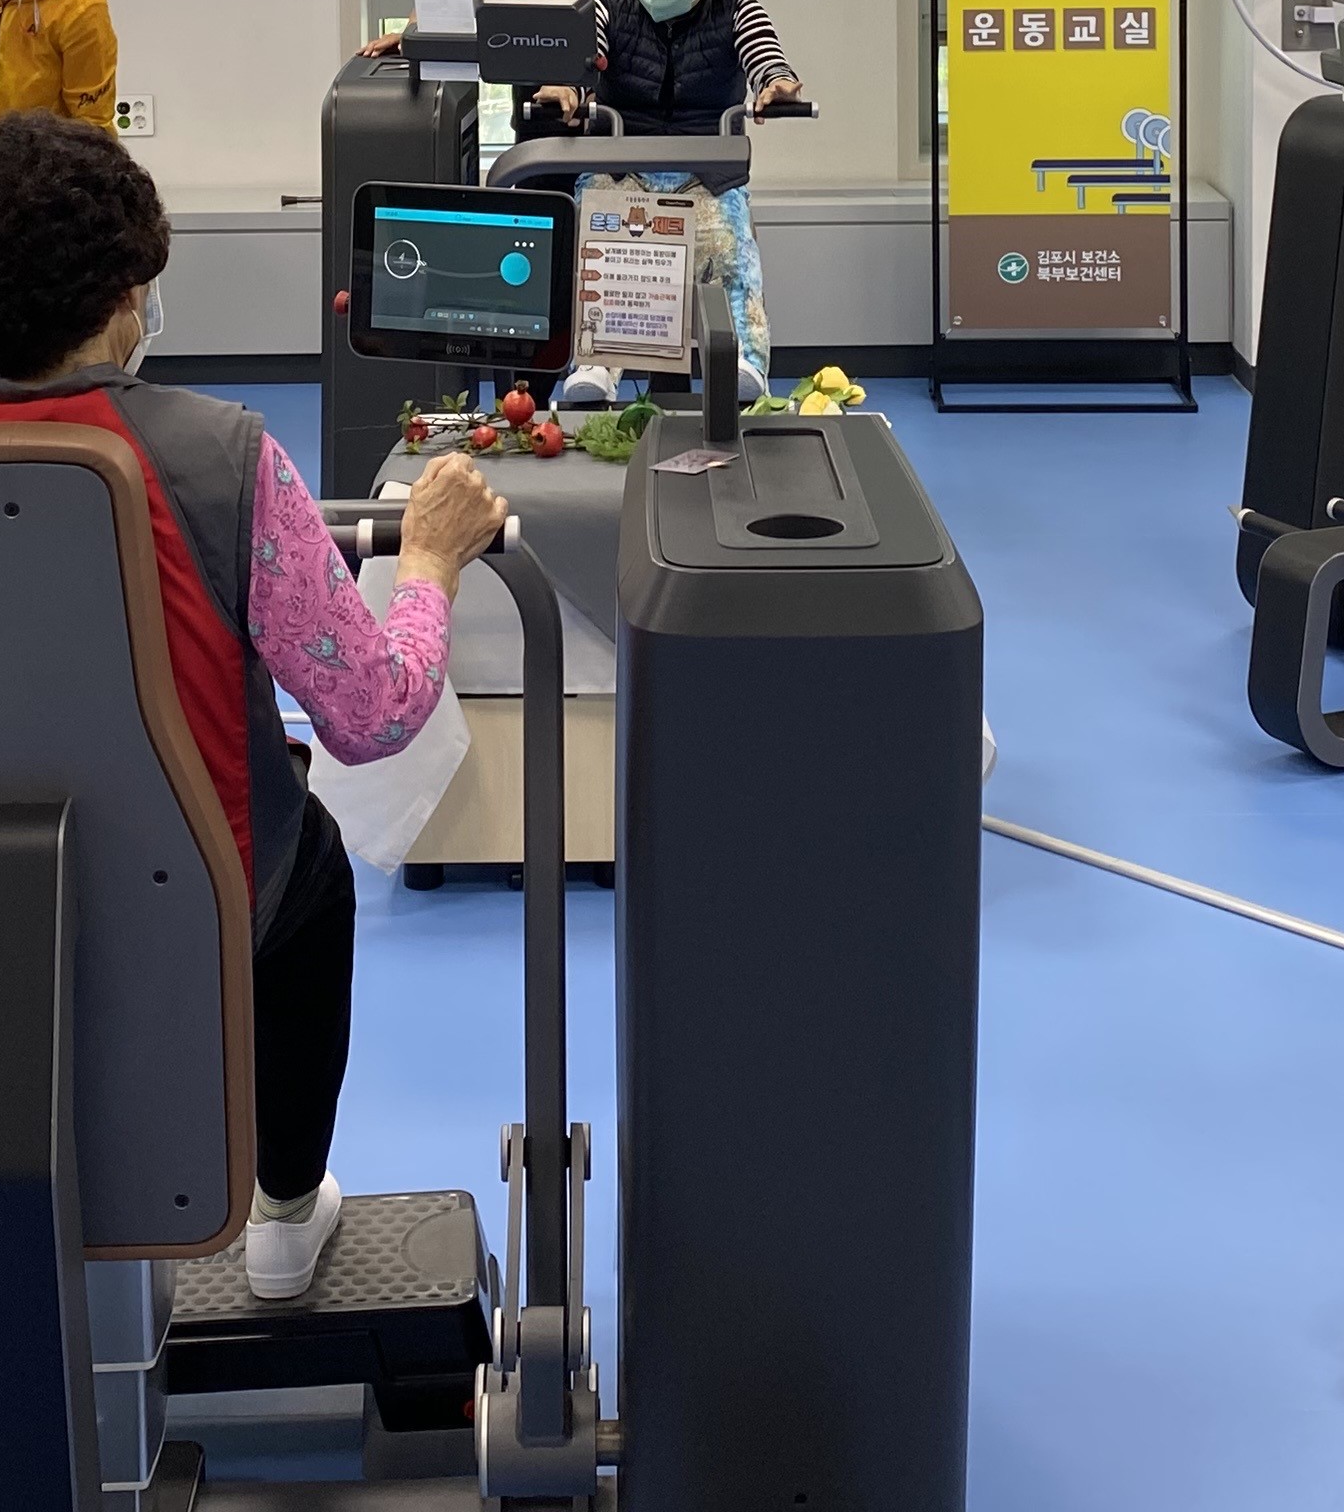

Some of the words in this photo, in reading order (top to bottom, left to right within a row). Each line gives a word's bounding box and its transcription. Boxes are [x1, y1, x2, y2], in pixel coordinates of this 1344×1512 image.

[512, 35, 567, 48] milon
[1038, 250, 1076, 264] 김포시
[1081, 250, 1120, 264] 보건소
[1037, 266, 1121, 282] 북부보건센터
